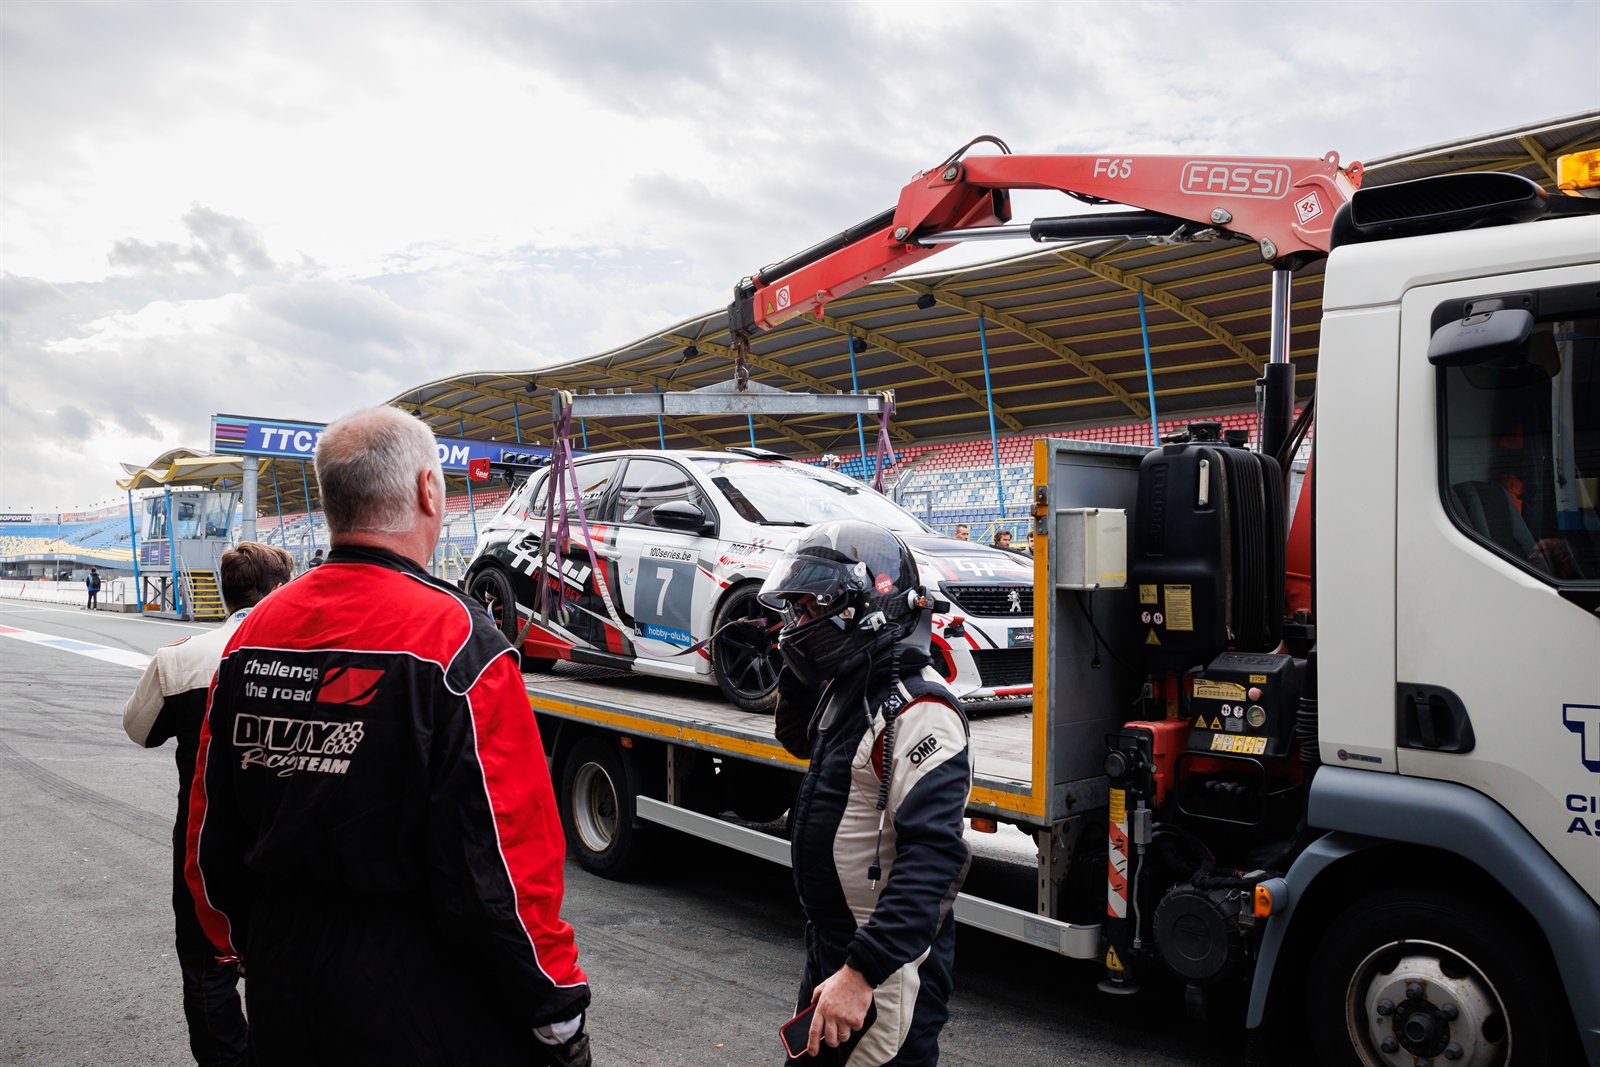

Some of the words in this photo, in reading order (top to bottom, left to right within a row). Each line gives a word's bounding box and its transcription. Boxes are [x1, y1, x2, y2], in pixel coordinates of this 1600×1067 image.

[1093, 158, 1133, 179] F65
[1187, 166, 1283, 195] FASSI
[1301, 201, 1315, 213] 45
[649, 547, 692, 561] 100series.be
[656, 566, 674, 617] 7
[648, 626, 690, 643] hobby-alu.be
[245, 682, 268, 698] the
[272, 687, 313, 702] road
[910, 737, 938, 764] OMP
[297, 756, 351, 774] TEAM
